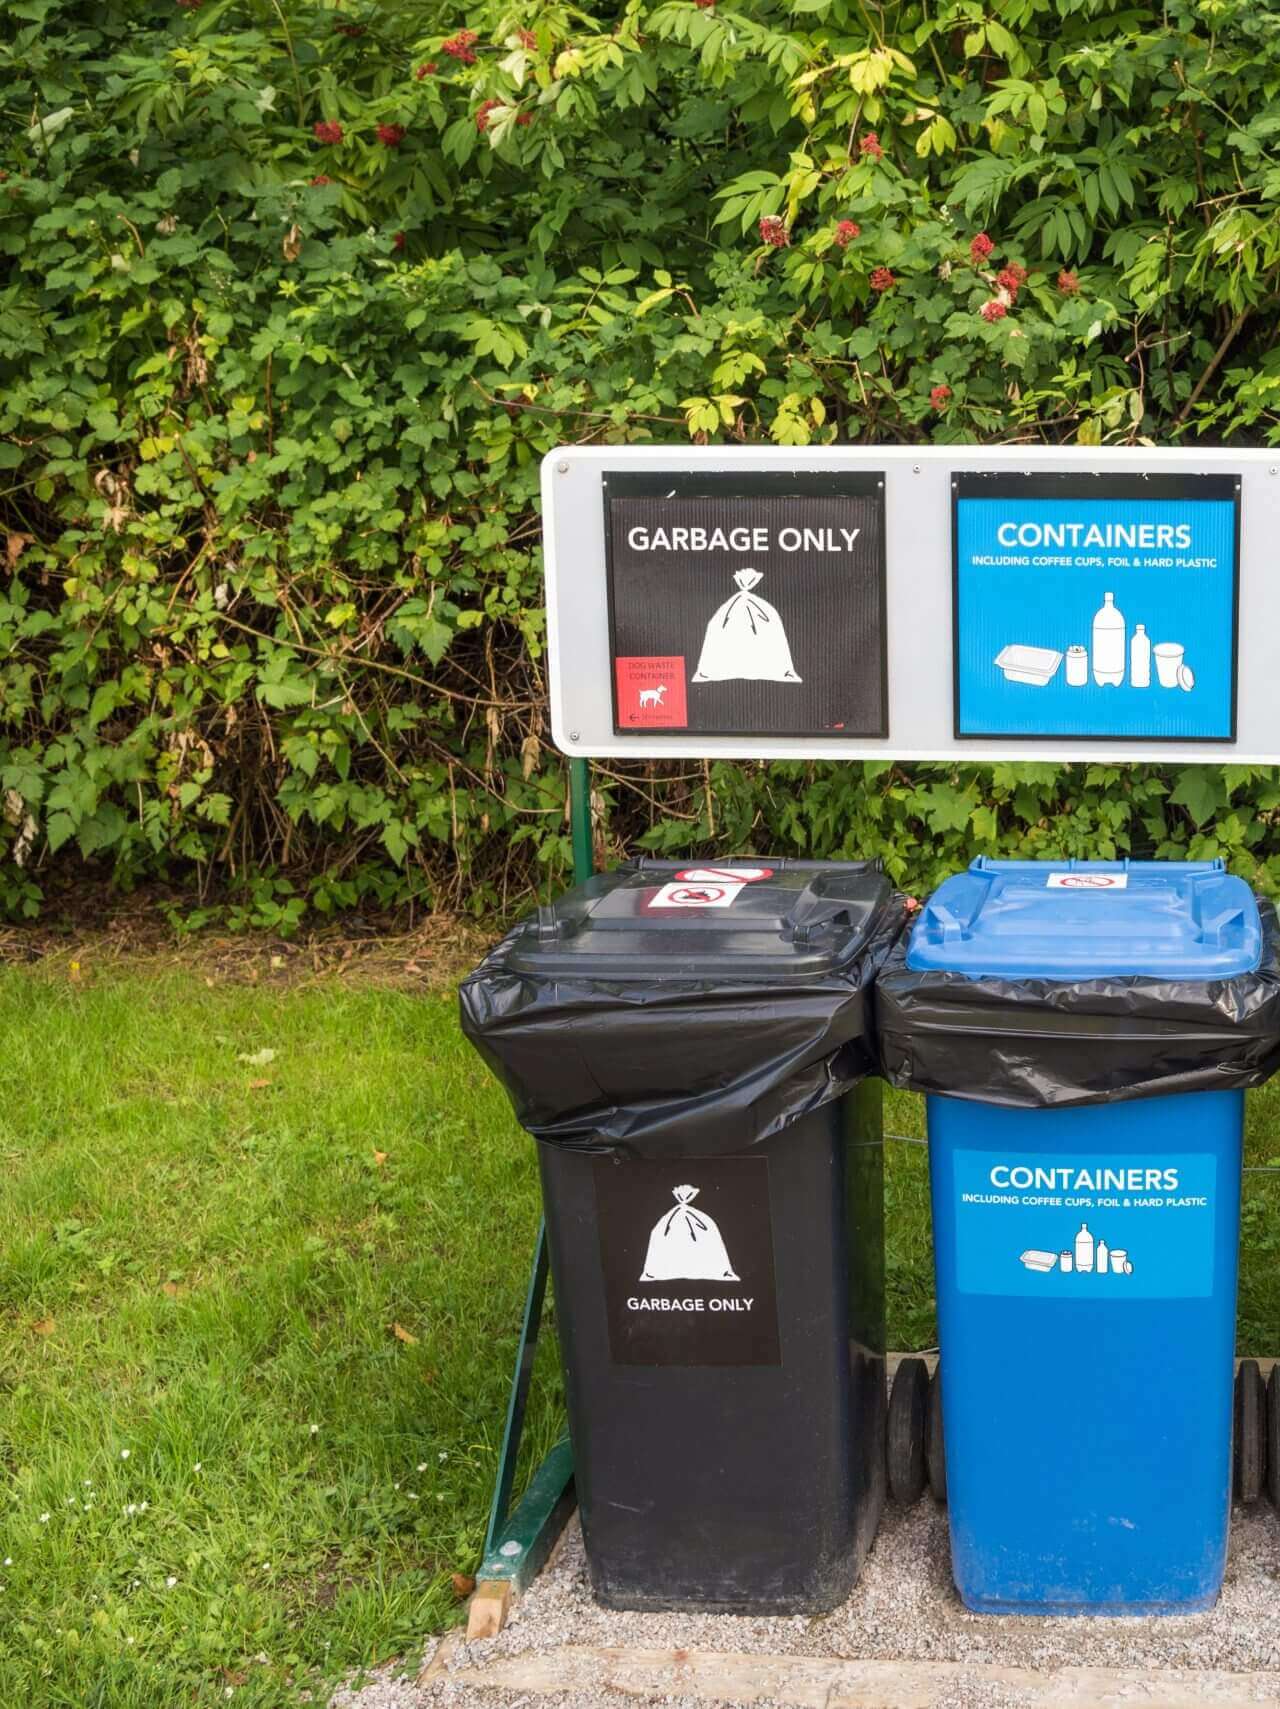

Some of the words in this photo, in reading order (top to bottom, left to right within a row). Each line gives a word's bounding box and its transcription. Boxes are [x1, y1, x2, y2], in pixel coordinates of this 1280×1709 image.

[627, 526, 769, 552] GARBAGE
[778, 527, 861, 552] ONLY
[997, 522, 1192, 549] CONTAINERS
[971, 555, 1030, 567] INCLUDING
[1032, 556, 1073, 567] COFFEE
[1074, 556, 1105, 568] CUPS,
[1107, 556, 1130, 568] FOIL
[1133, 557, 1141, 568] &
[1143, 558, 1173, 569] HARD
[1175, 558, 1217, 569] PLASTIC
[990, 1165, 1179, 1191] CONTAINERS
[962, 1193, 1018, 1206] INCLUDING
[1021, 1196, 1063, 1207] COFFEE
[1065, 1197, 1095, 1208] CUPS,
[1097, 1198, 1121, 1208] FOIL
[1123, 1198, 1131, 1208] &
[1133, 1197, 1164, 1208] HARD
[1166, 1196, 1208, 1208] PLASTIC
[626, 1297, 705, 1312] GARBAGE
[708, 1298, 755, 1313] ONLY
